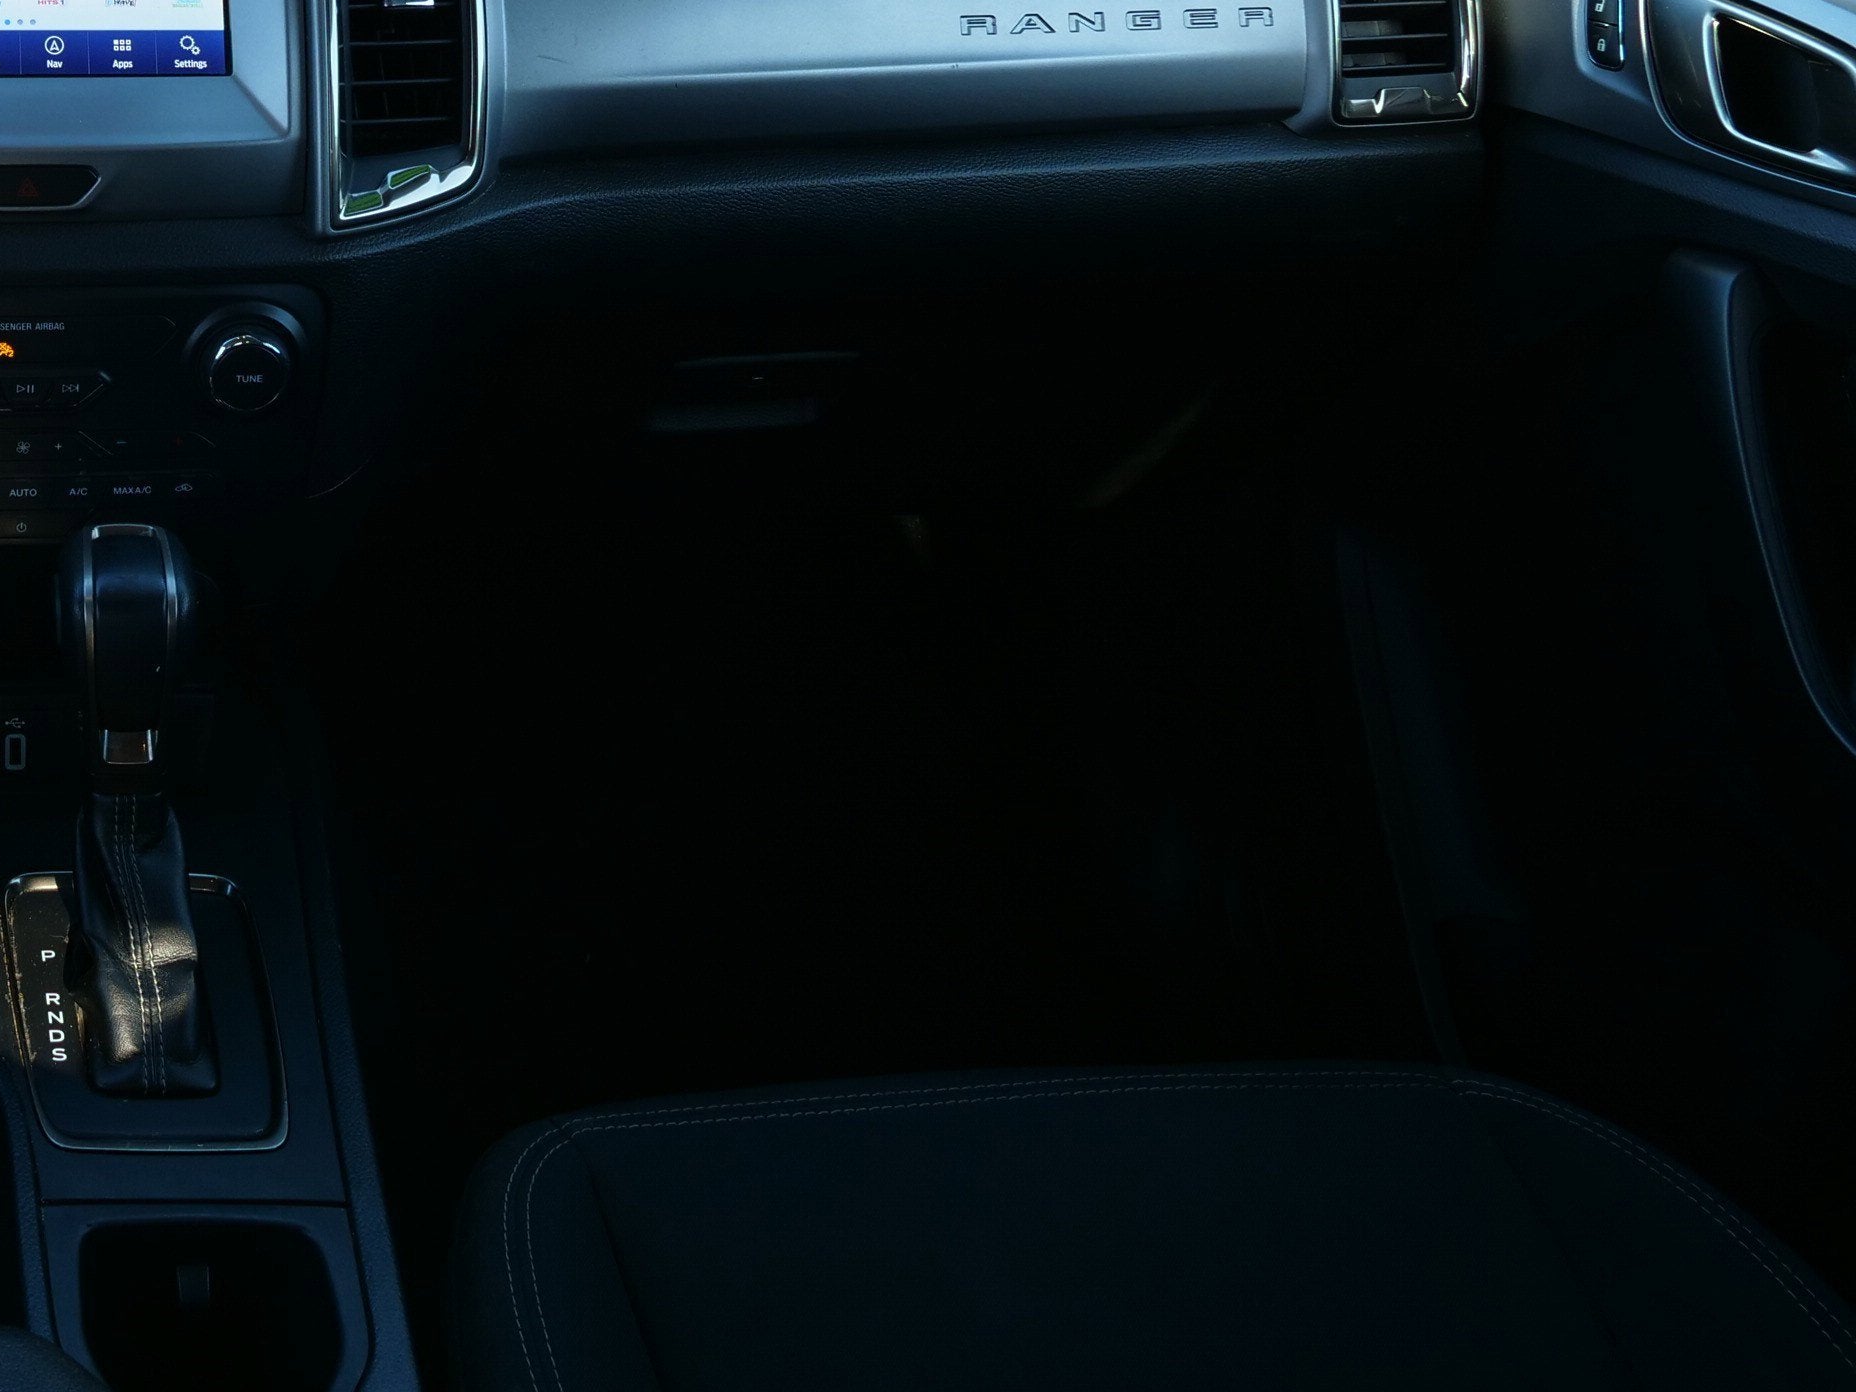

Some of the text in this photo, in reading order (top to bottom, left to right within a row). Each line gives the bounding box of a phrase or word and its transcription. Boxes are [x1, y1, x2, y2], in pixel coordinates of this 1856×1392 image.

[959, 7, 1275, 36] RANGER
[46, 59, 63, 69] Nav
[112, 59, 133, 71] Apps
[174, 59, 208, 71] Settings
[31, 322, 65, 331] AIRBAG
[236, 374, 263, 383] TUNE
[9, 488, 37, 497] AUTO
[69, 487, 88, 496] A/C
[113, 485, 152, 496] MAX A/C
[41, 949, 56, 962] P
[45, 992, 61, 1006] R
[47, 1011, 64, 1024] N
[48, 1029, 65, 1043] D
[51, 1048, 68, 1062] S
